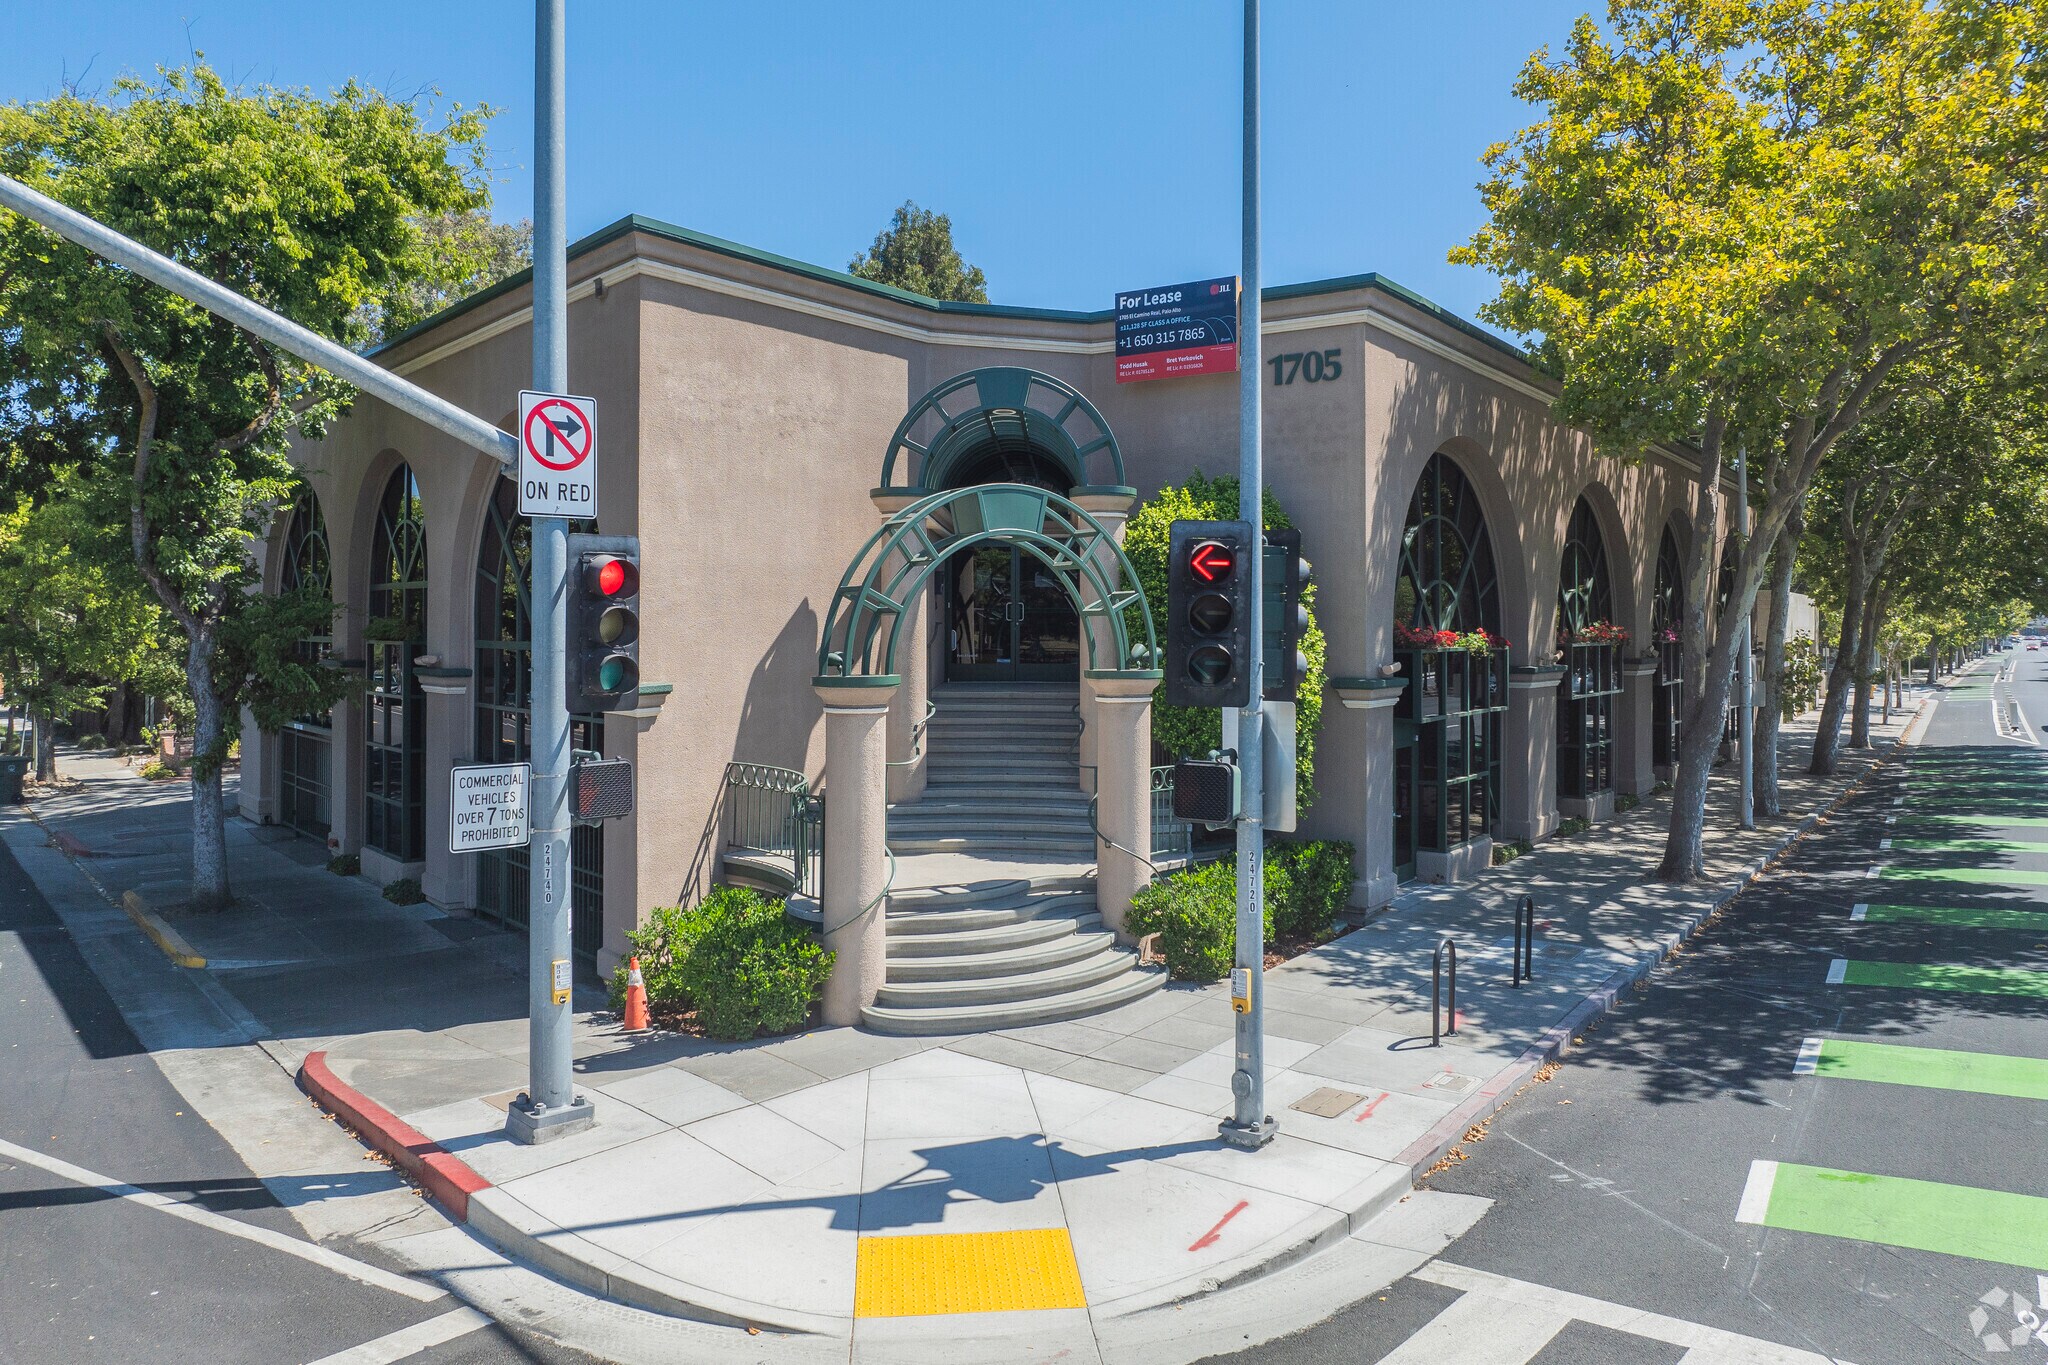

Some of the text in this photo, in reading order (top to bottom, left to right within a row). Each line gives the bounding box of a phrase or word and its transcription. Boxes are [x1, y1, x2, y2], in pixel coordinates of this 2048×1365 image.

[1219, 284, 1231, 293] JLL
[1119, 291, 1182, 310] For Lease
[1119, 313, 1130, 321] 1705
[1134, 311, 1151, 319] Camino
[1151, 309, 1162, 317] Real,
[1141, 321, 1147, 329] SF
[1148, 319, 1166, 327] CLASS
[1171, 316, 1191, 324] OFFICE
[1119, 336, 1132, 348] +1
[1134, 333, 1154, 347] 650
[1156, 331, 1175, 344] 315
[1178, 327, 1205, 341] 7865
[1132, 360, 1149, 368] Husak
[1178, 353, 1204, 362] Yerkovich
[1267, 348, 1342, 386] 1705
[526, 480, 591, 502] ON RED
[459, 773, 524, 789] COMMERCIAL
[467, 791, 516, 806] VEHICLES
[457, 807, 525, 826] OVER 7 TONS
[461, 825, 520, 842] PROHIBITED
